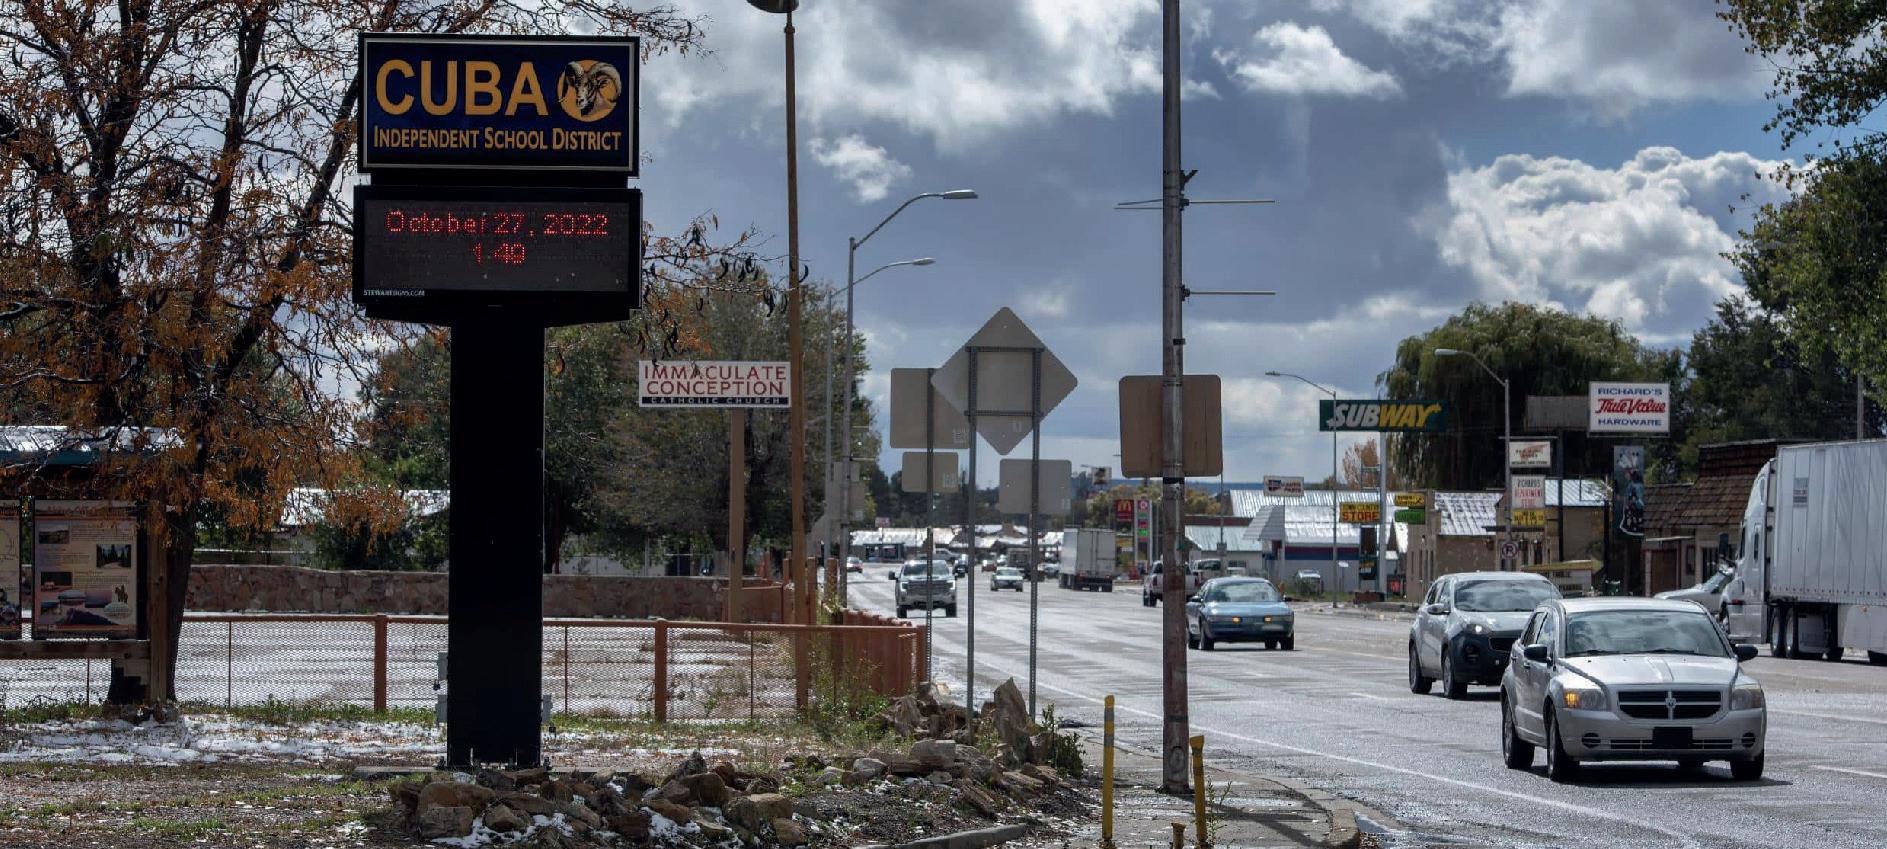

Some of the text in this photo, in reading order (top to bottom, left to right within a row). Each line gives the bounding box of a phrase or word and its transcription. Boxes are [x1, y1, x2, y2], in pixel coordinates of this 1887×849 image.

[375, 59, 549, 116] CUBA
[374, 125, 622, 150] INDEPENDENT SCHOOL DISTRICT
[386, 210, 609, 237] October 27, 2022
[644, 365, 786, 380] IMMACULATE
[646, 381, 783, 395] CONCEPTION
[1597, 387, 1663, 395] RICHARD'S
[651, 397, 780, 405] CATHOLIC CHURCH
[1595, 397, 1666, 416] True Value
[1326, 403, 1442, 428] SUBWAY
[1598, 418, 1662, 427] HARDWARE
[1341, 511, 1379, 521] STORE
